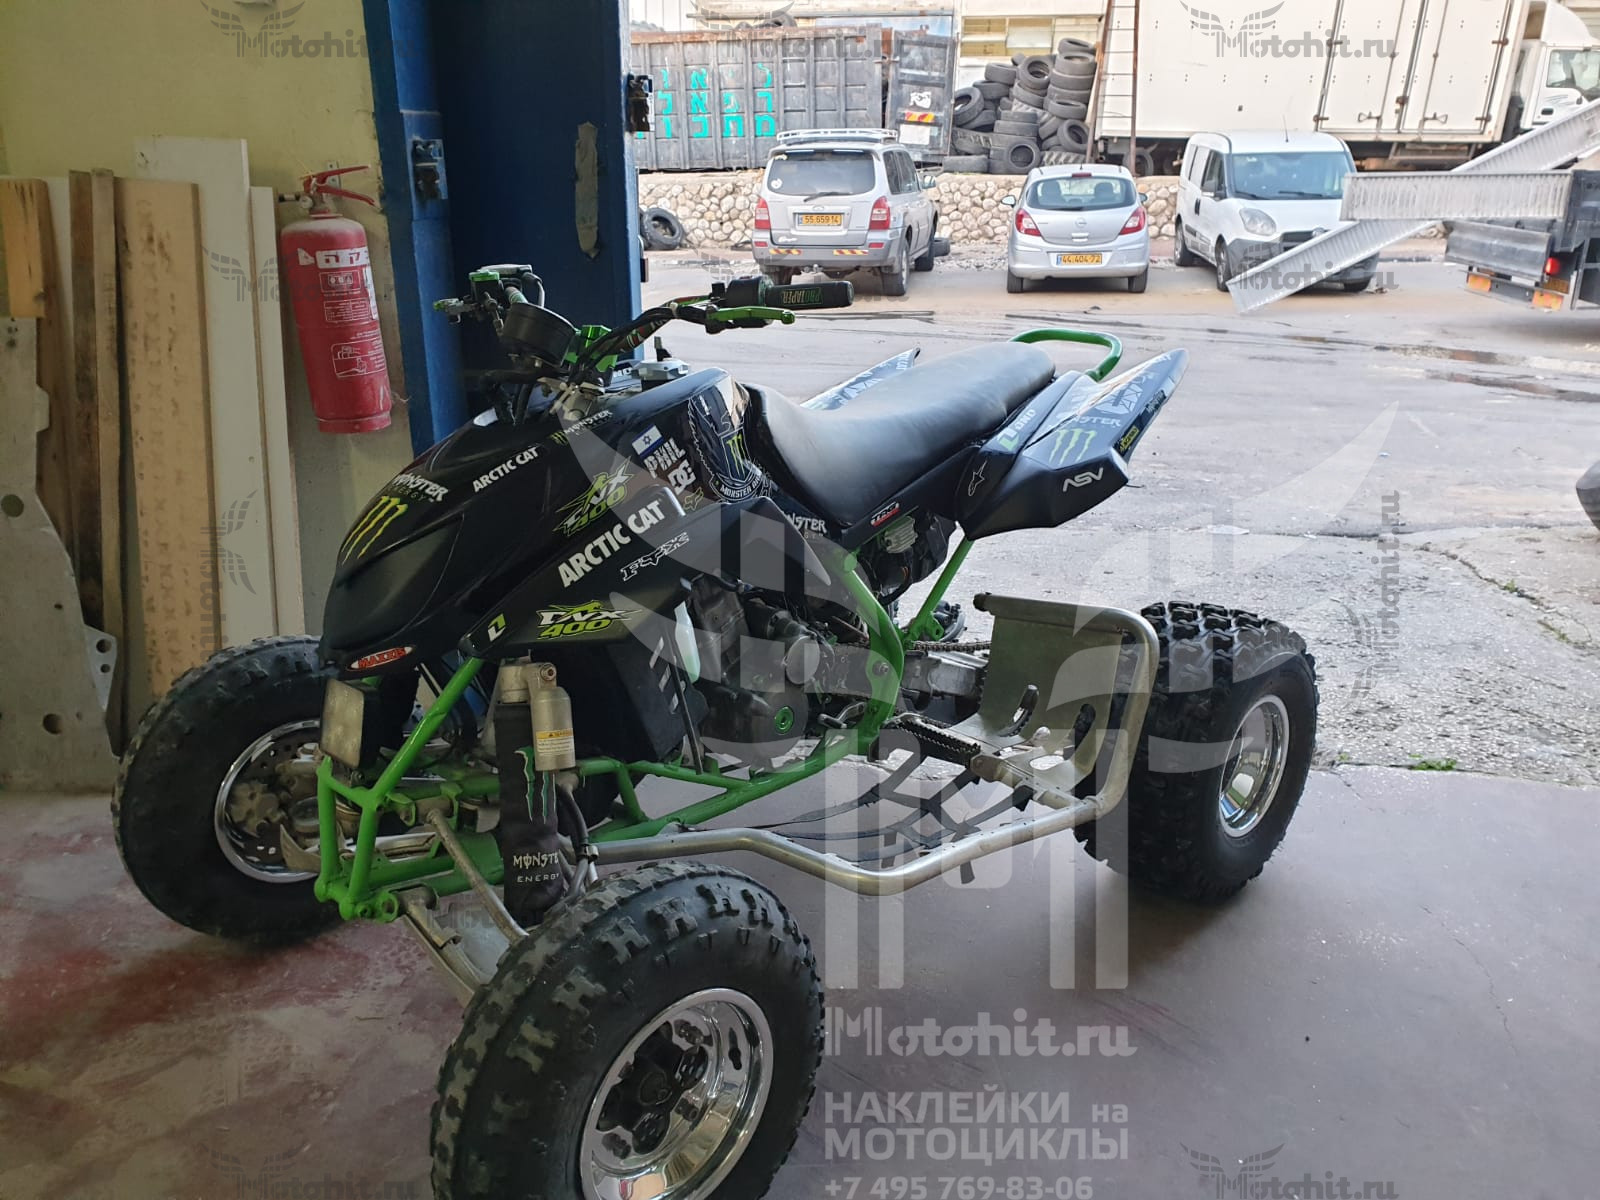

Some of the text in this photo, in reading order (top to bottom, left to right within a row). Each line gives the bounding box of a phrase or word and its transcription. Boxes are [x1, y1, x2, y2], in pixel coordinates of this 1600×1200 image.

[640, 114, 776, 138] מתכו
[472, 446, 539, 492] ARCTIC CAT
[557, 500, 666, 588] ARCTIC CAT
[537, 619, 613, 639] 400
[513, 851, 559, 870] MONSTE
